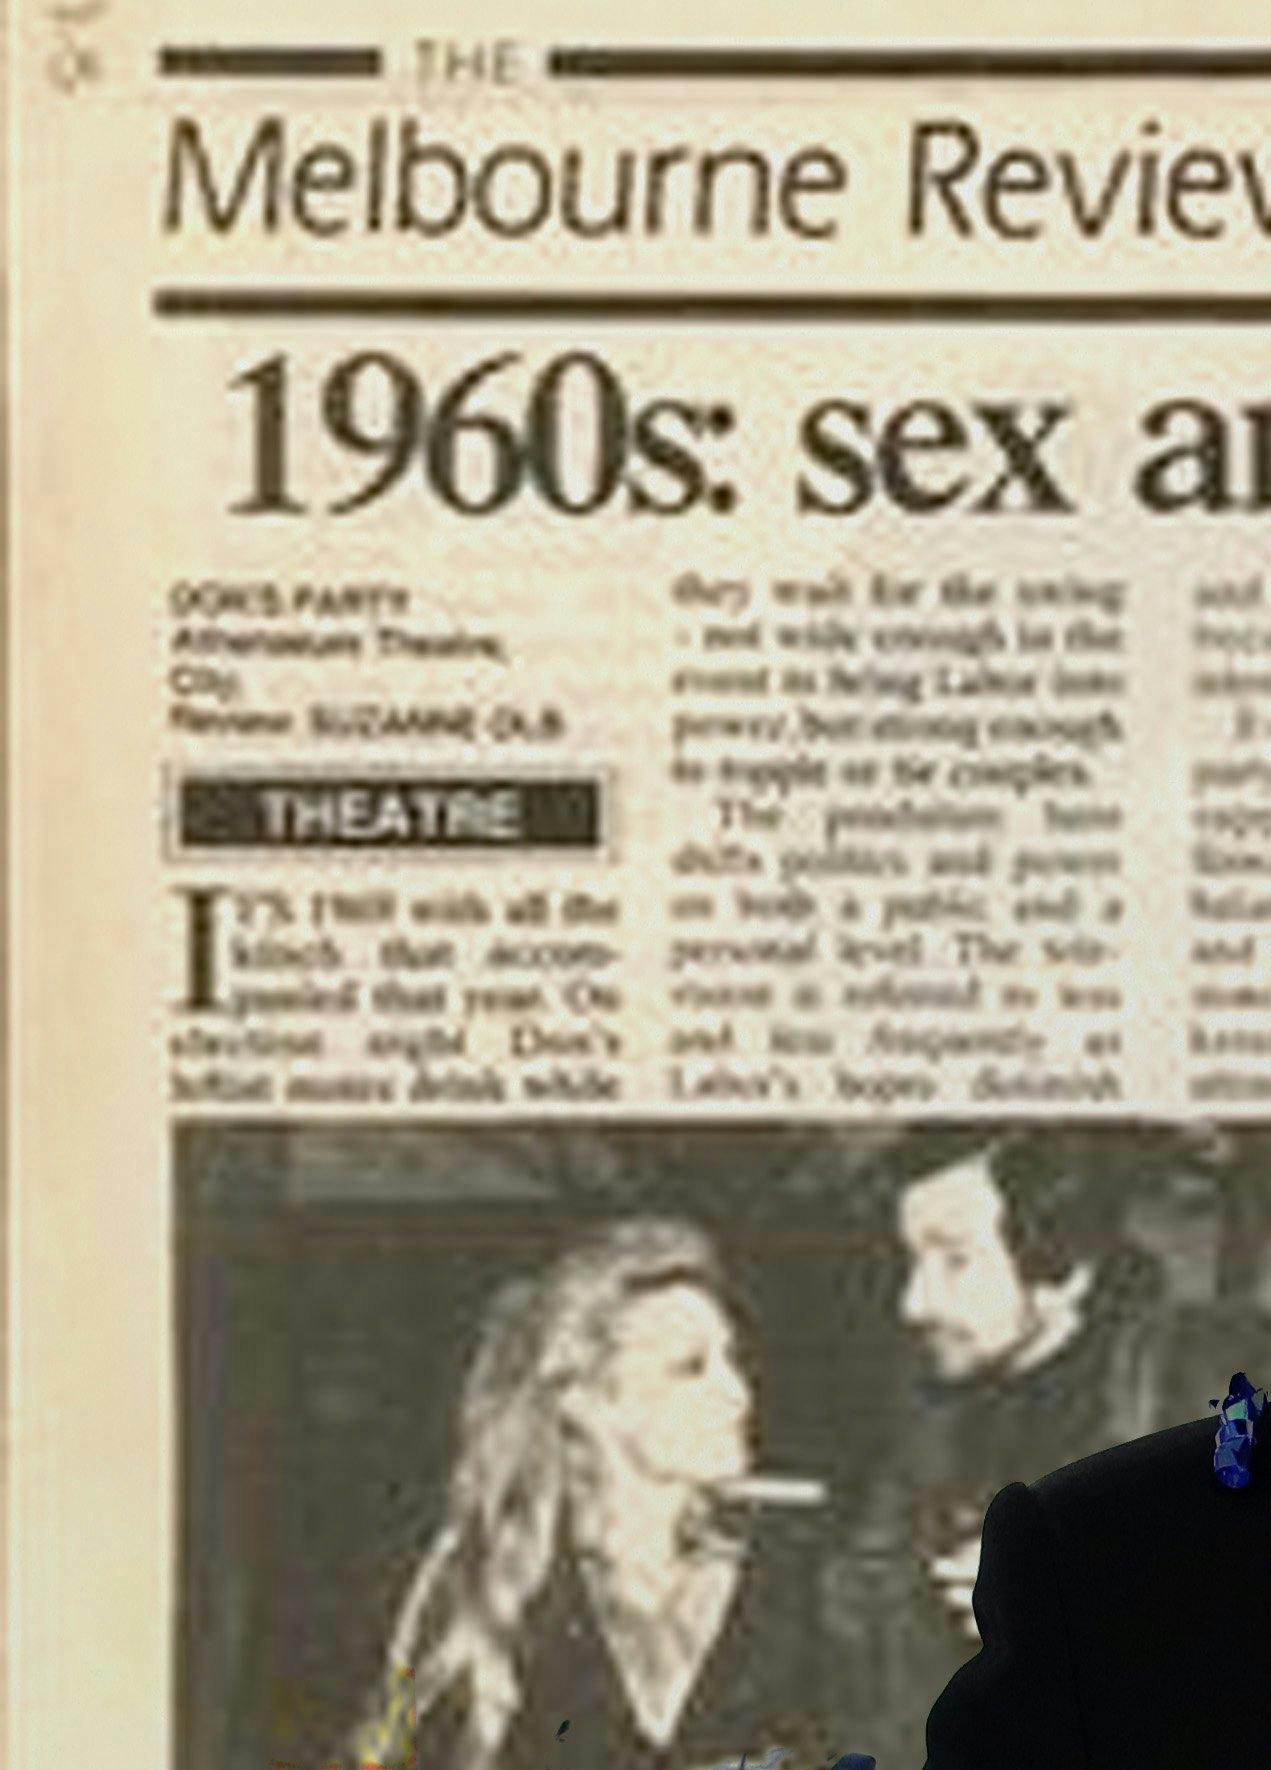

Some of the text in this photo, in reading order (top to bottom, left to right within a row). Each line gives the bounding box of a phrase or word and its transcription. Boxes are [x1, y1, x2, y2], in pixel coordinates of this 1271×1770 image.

[413, 40, 521, 86] THE
[161, 116, 847, 241] Melbourne
[226, 349, 737, 516] 1960s:
[799, 398, 1076, 516] sex
[259, 790, 523, 838] THEATRE
